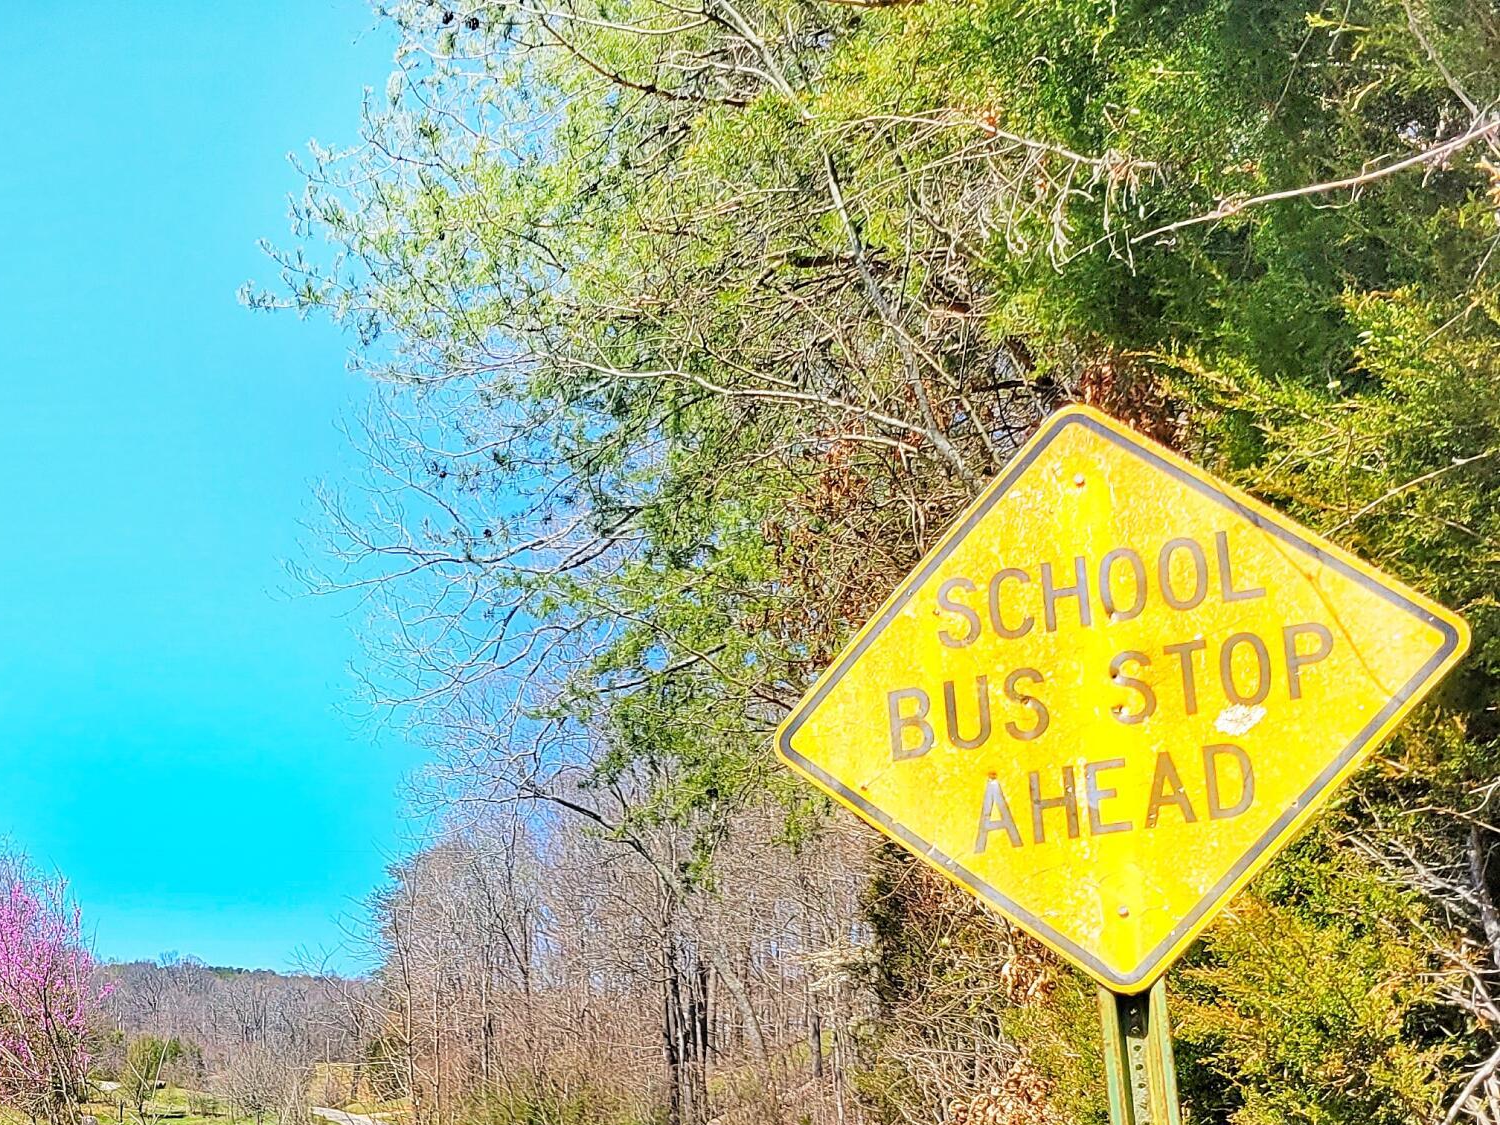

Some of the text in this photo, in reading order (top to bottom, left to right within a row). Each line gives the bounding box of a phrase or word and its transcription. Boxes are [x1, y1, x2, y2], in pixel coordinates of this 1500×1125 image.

[936, 530, 1266, 650] SCHOOL
[887, 622, 1334, 762] BUS STOP
[974, 743, 1255, 855] AHEAD
